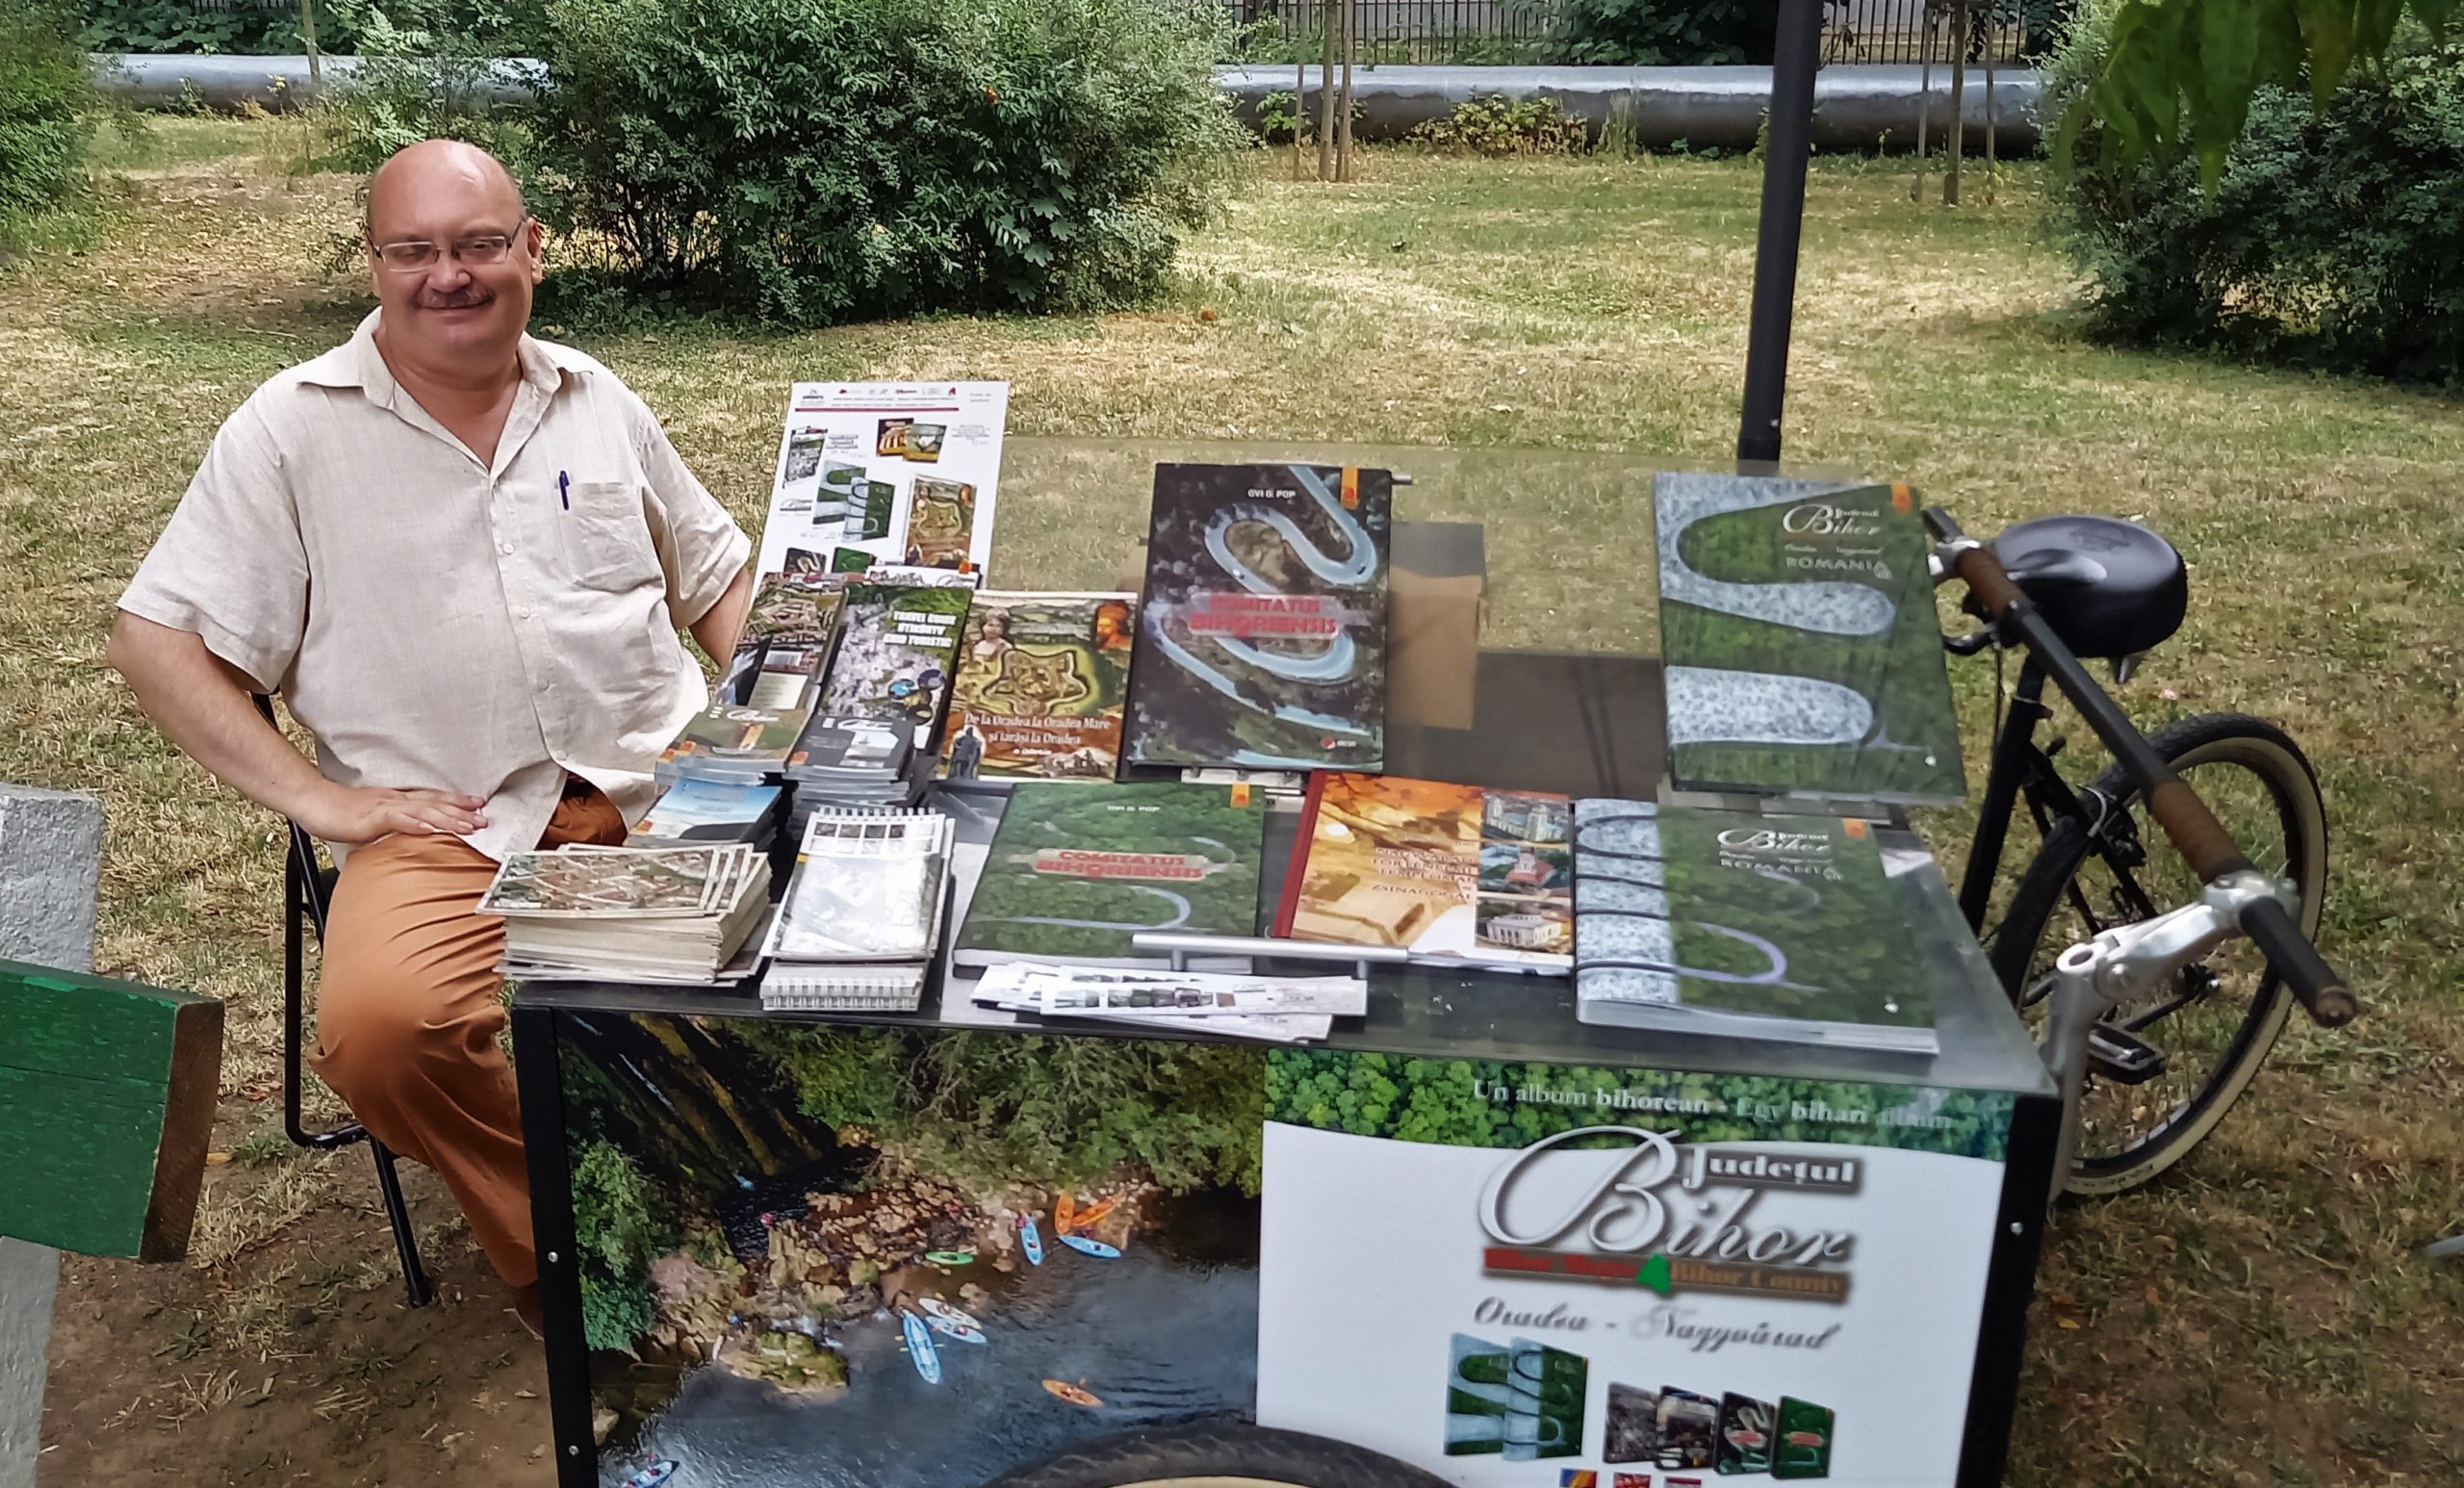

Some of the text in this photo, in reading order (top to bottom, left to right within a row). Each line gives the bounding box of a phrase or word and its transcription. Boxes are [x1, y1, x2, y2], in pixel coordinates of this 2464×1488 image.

[964, 712, 980, 726] De
[981, 713, 991, 726] la
[993, 715, 1030, 727] Oradea
[1032, 716, 1042, 729] la
[1084, 716, 1112, 730] Mare
[1032, 731, 1041, 743] la
[1043, 732, 1082, 745] Oradea
[1060, 851, 1185, 865] COMITATUS
[1035, 859, 1203, 878] BIHORIENSIS
[1474, 1079, 1509, 1101] Un
[1515, 1083, 1587, 1106] album
[1596, 1087, 1711, 1116] bihorean
[1736, 1096, 1780, 1122] Egy
[1790, 1100, 1868, 1124] bihari
[1477, 1124, 1848, 1266] Bihor
[1473, 1296, 1589, 1332] Oradea
